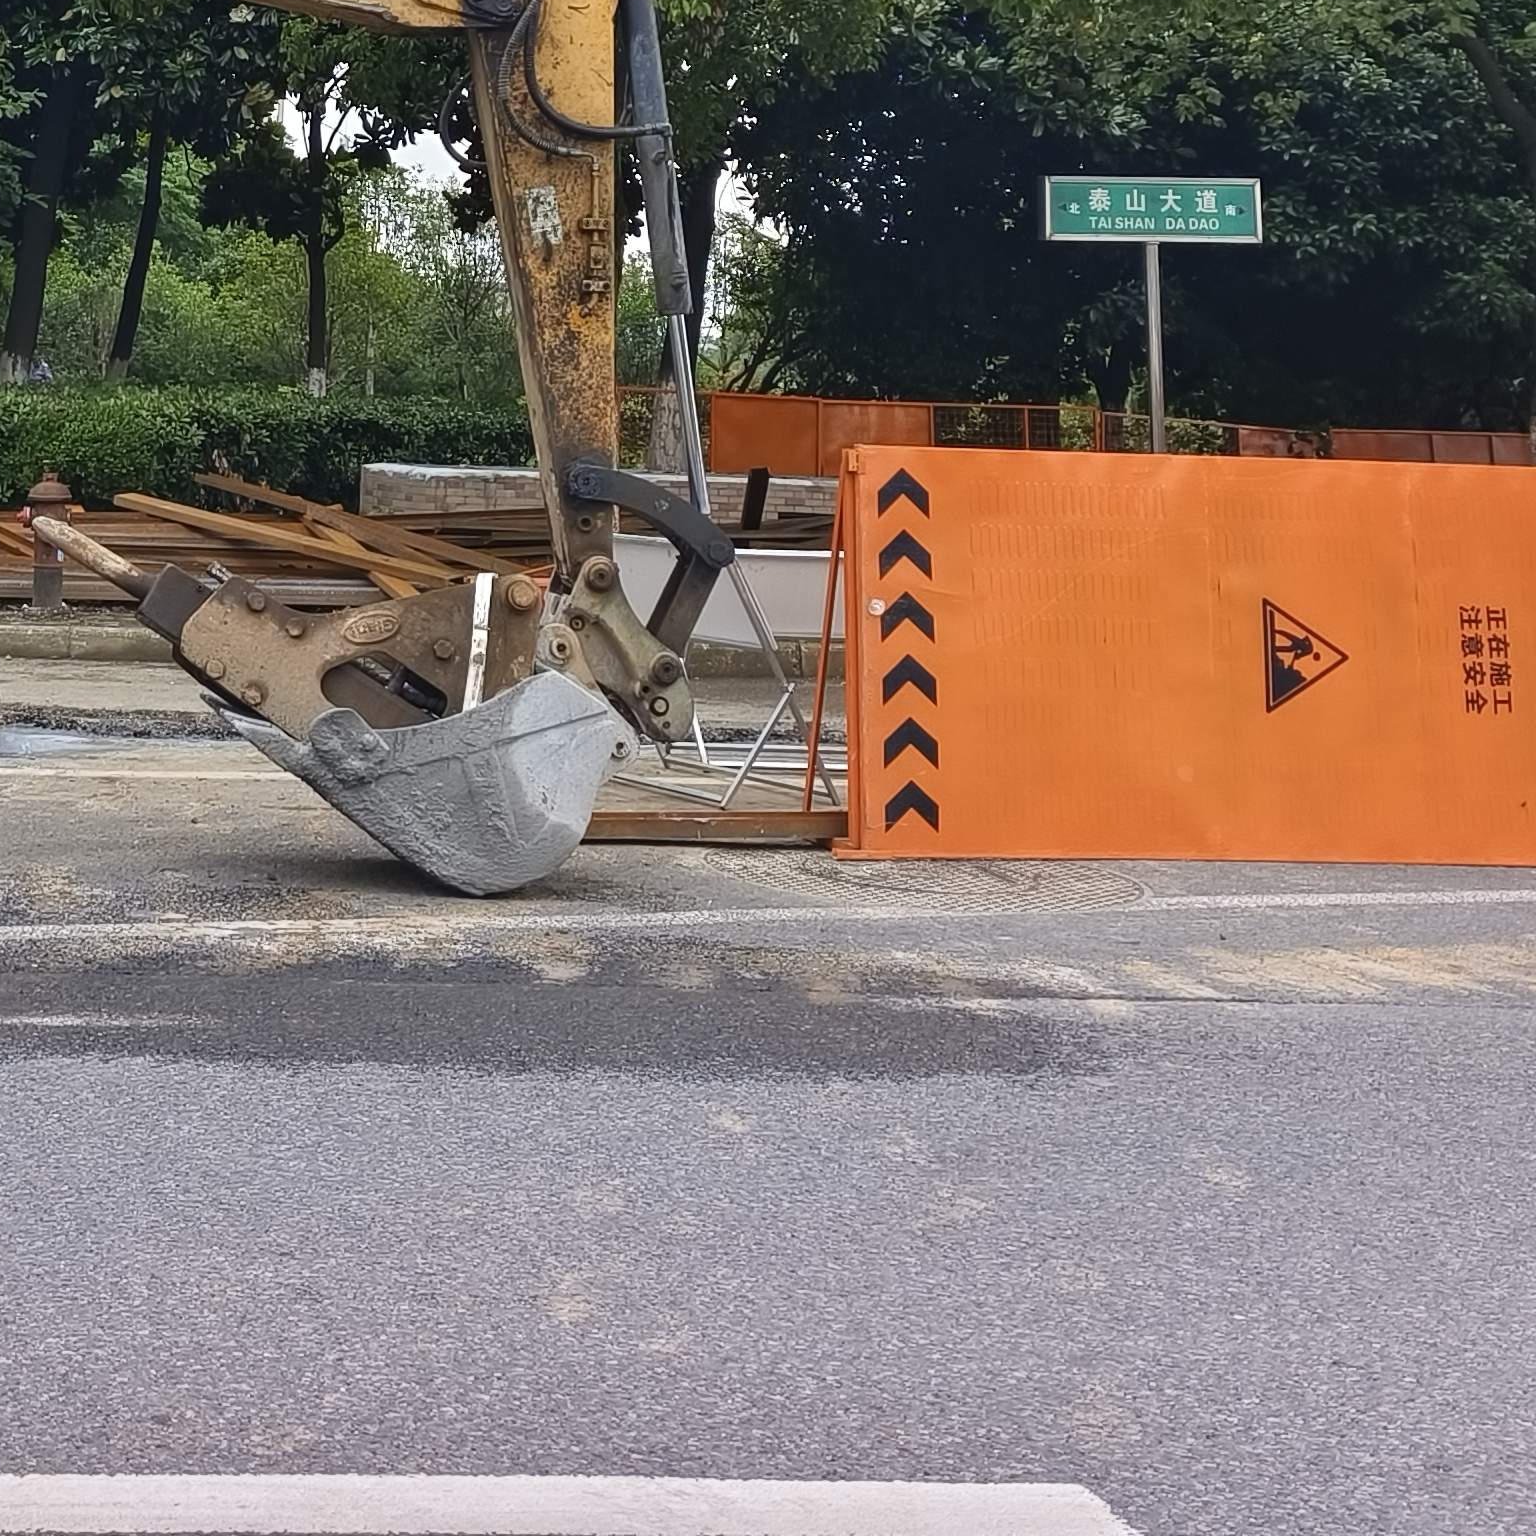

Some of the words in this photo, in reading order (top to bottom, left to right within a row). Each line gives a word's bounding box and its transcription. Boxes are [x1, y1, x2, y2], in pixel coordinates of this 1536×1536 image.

[1068, 203, 1081, 215] 北
[1088, 188, 1218, 214] 泰山大道
[1459, 605, 1488, 714] 注意安全
[1486, 606, 1512, 714] 正在施工
